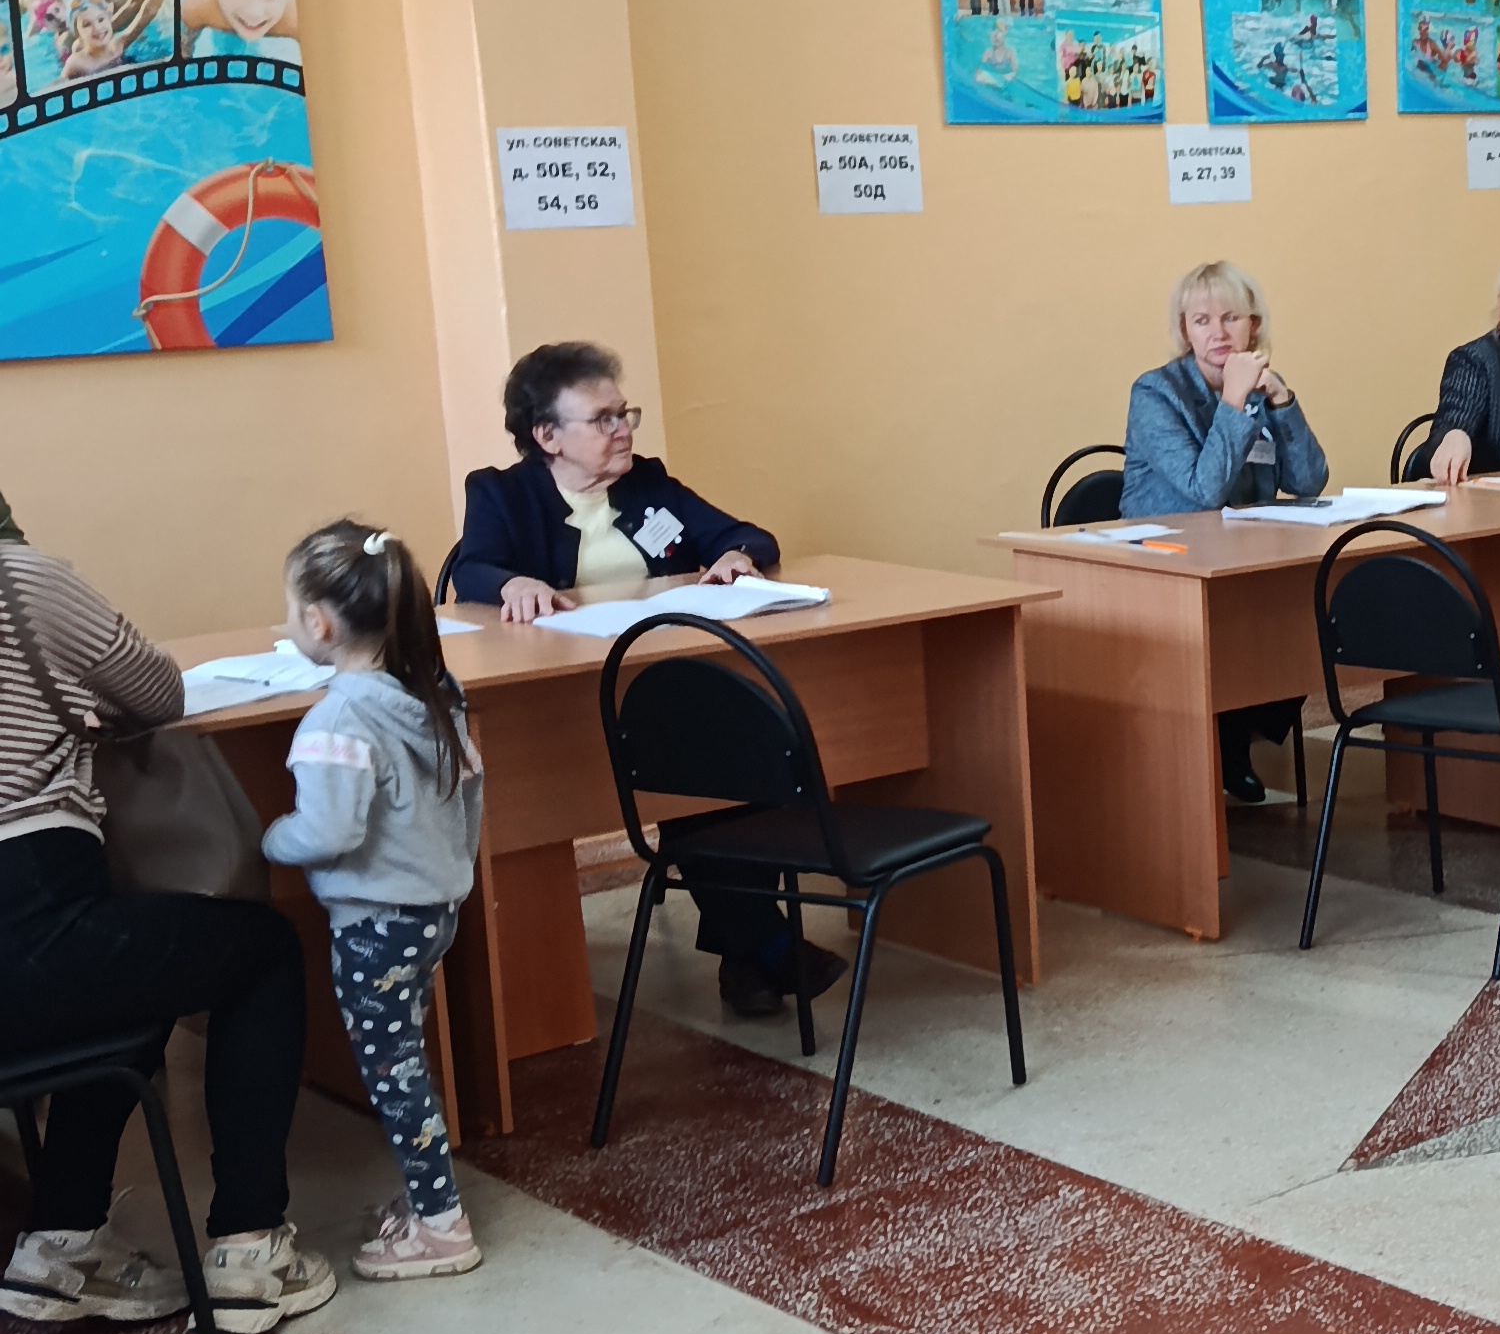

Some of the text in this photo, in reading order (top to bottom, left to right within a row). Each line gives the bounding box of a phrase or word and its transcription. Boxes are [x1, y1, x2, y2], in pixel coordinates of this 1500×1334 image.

[506, 135, 621, 151] ул. СОВЕТСКАЯ,
[821, 132, 913, 146] ул. СОВЕТСКАЯ,
[512, 161, 616, 181] д. 50Е, 52,
[838, 155, 874, 173] 50А,
[879, 155, 914, 172] 50Б,
[1196, 166, 1217, 182] 27,
[1220, 166, 1236, 180] 39
[853, 184, 886, 201] 50Д
[538, 194, 599, 214] 54, 56
